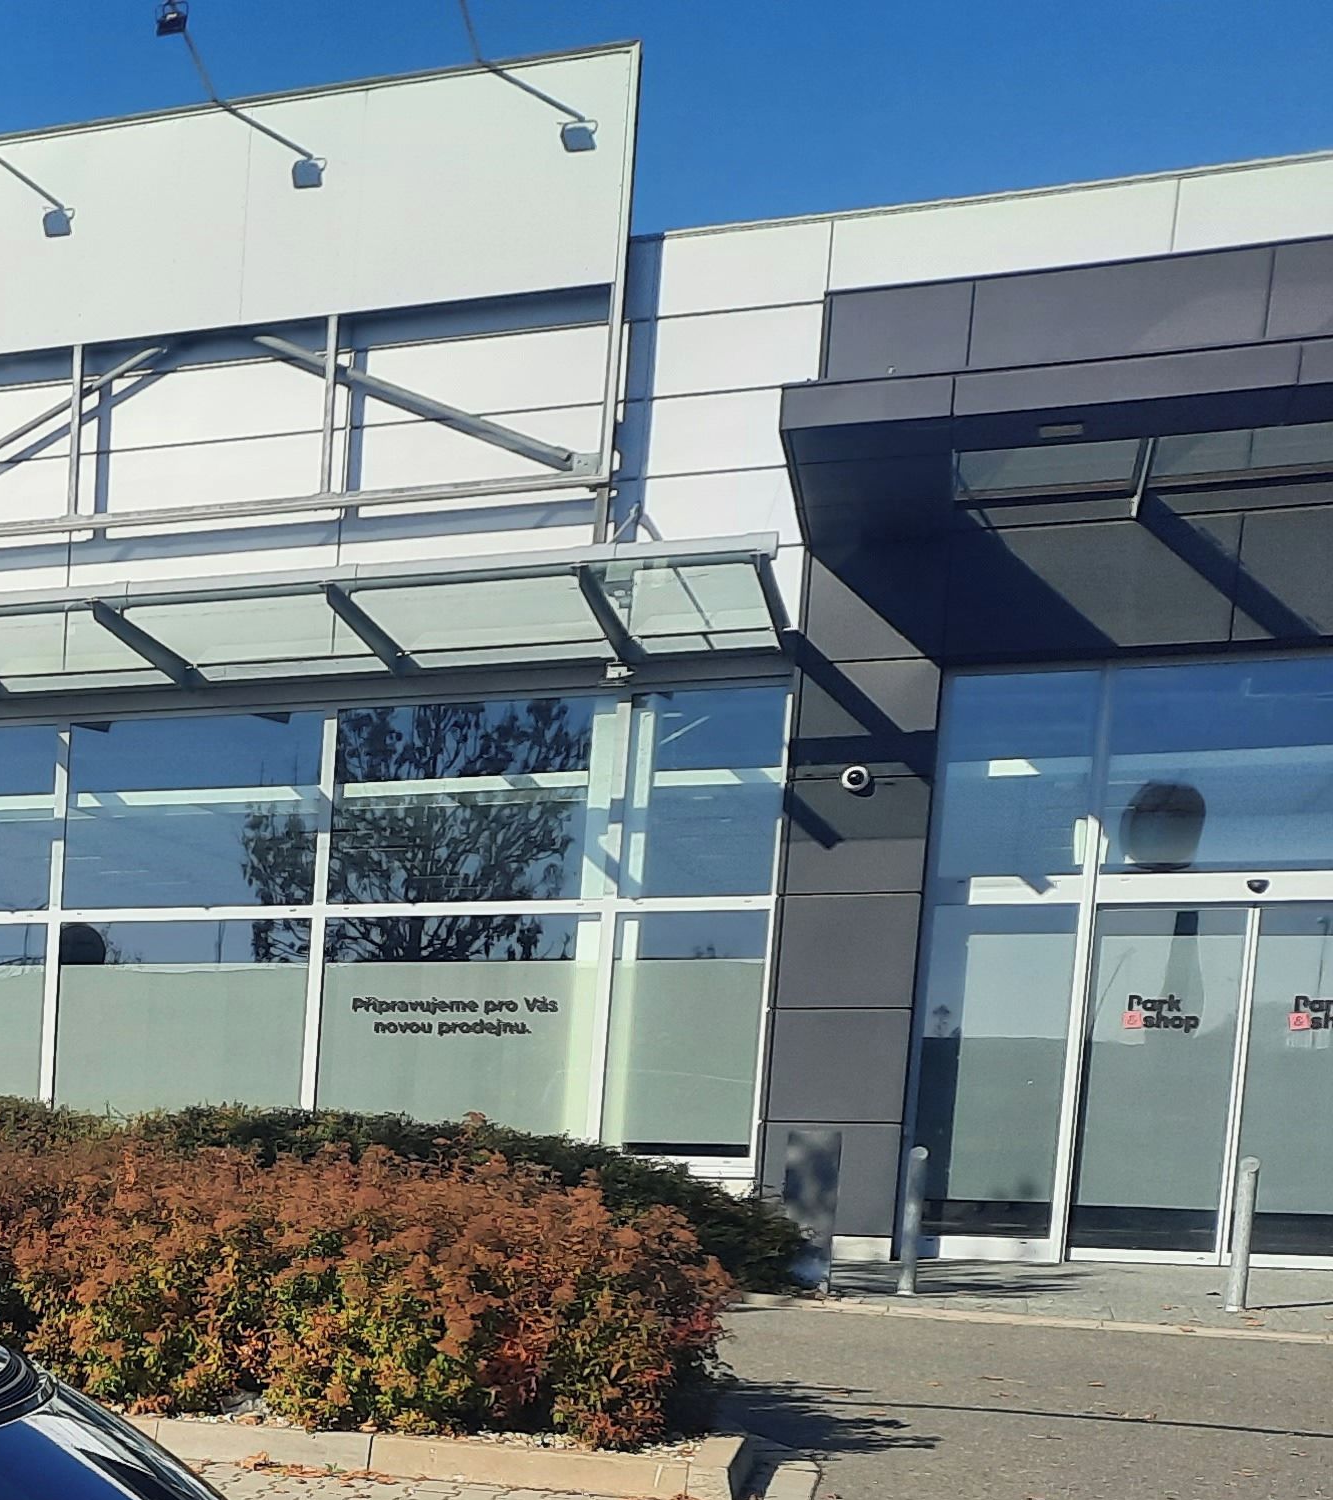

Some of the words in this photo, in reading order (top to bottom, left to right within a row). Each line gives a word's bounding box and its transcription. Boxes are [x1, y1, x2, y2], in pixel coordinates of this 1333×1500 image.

[352, 997, 479, 1015] Připravujeme
[484, 999, 519, 1015] pro
[523, 996, 559, 1013] Vás
[1127, 993, 1181, 1012] Park
[1293, 995, 1333, 1012] Par
[374, 1020, 433, 1034] novou
[437, 1018, 532, 1036] prodejnu.
